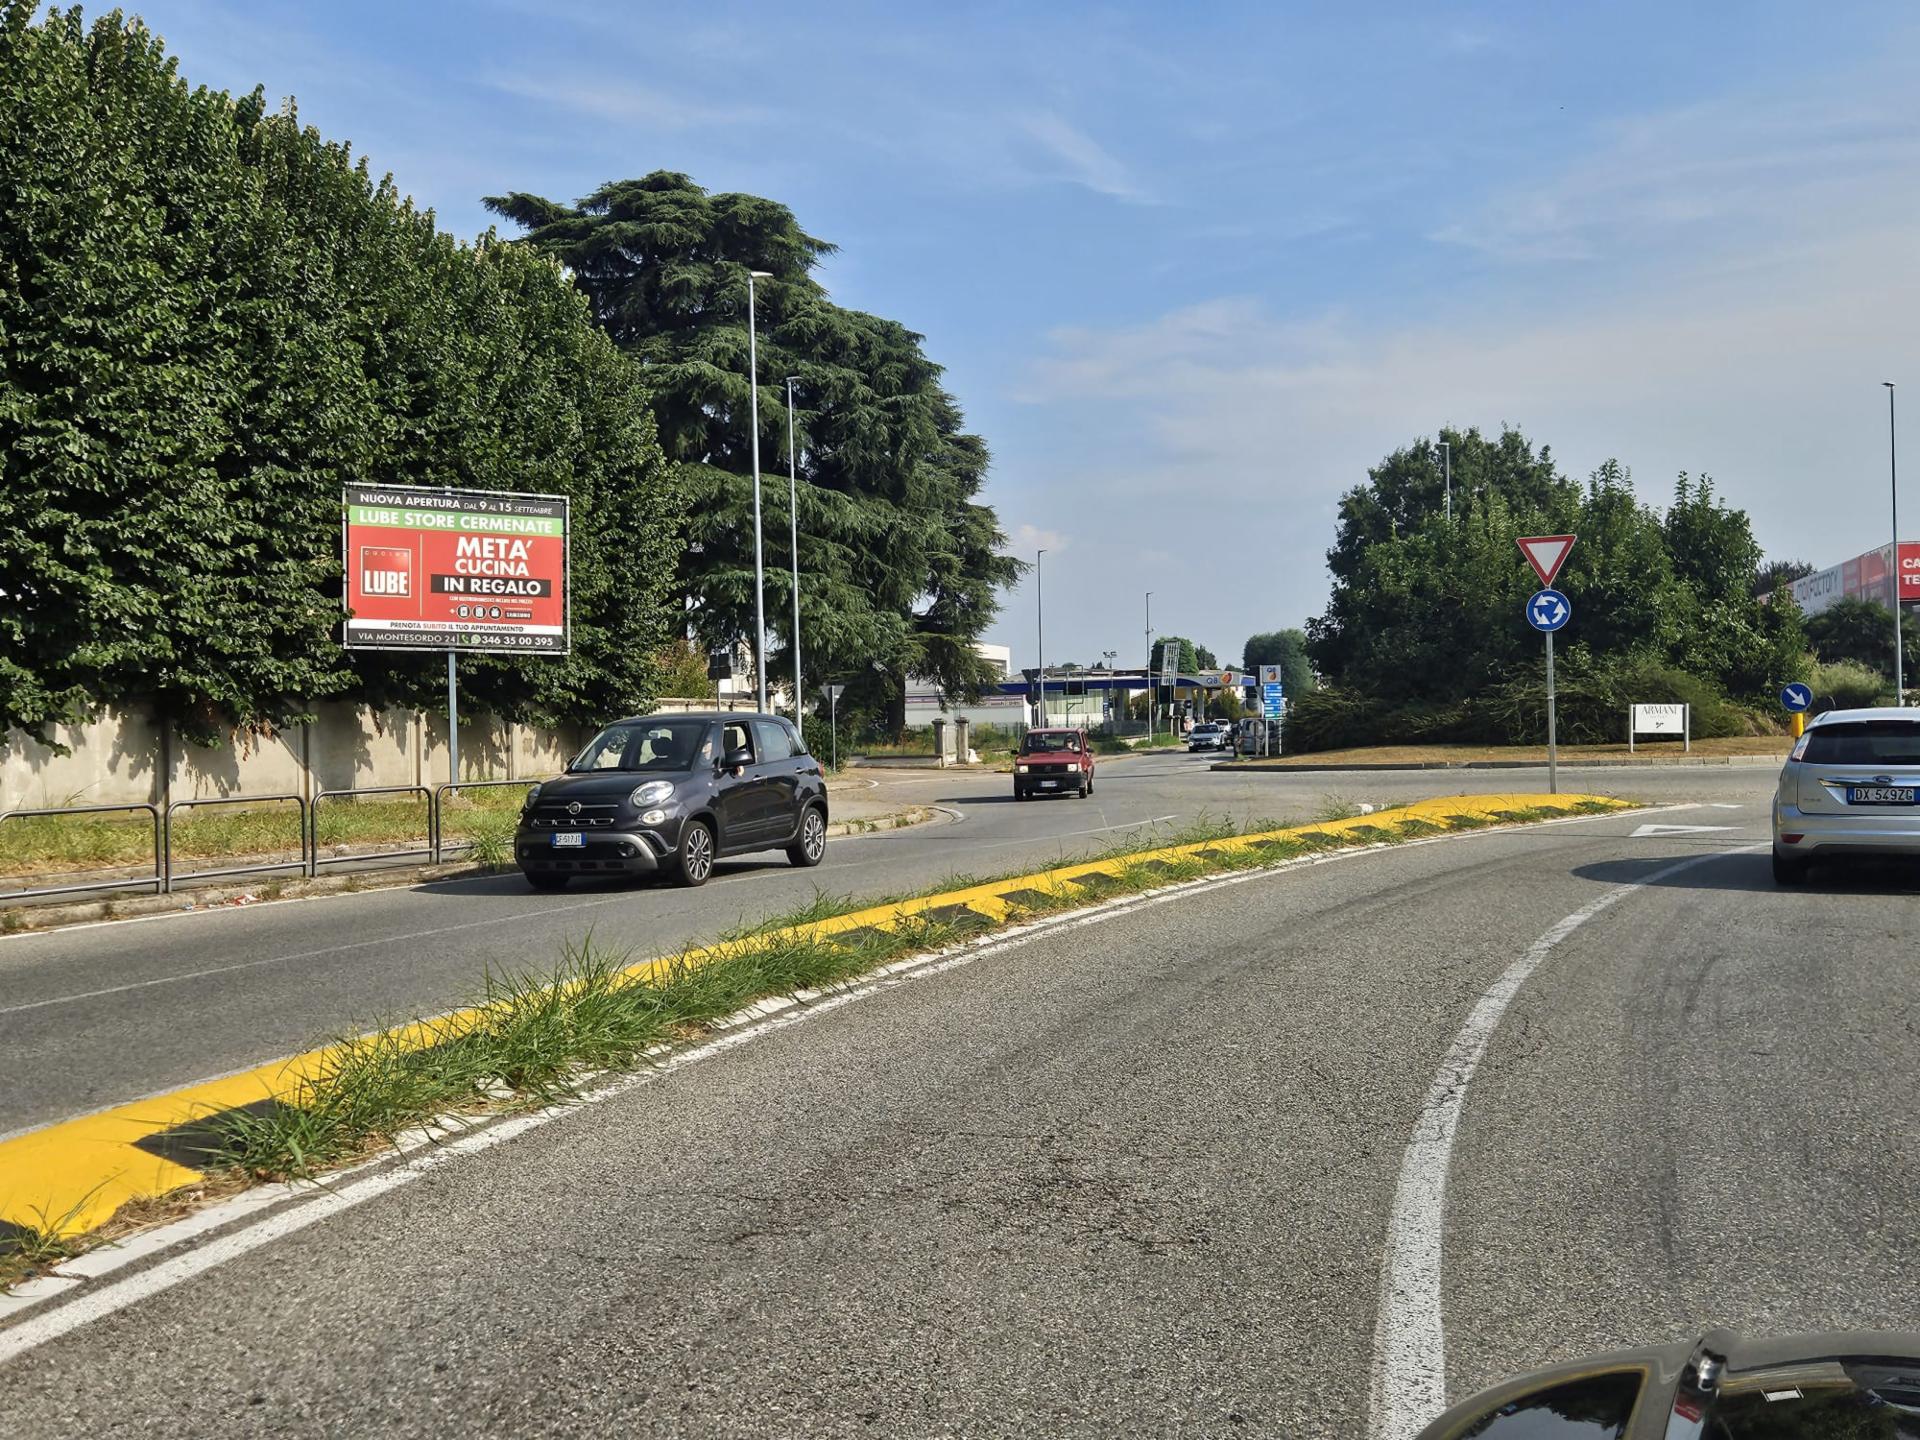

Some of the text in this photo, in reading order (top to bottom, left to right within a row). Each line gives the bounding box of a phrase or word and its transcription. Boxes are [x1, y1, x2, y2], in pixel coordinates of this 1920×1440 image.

[360, 493, 403, 505] NUOVA
[405, 496, 461, 509] APERTURA
[463, 502, 478, 510] DAL
[479, 501, 487, 510] 9
[499, 502, 512, 512] 15
[514, 505, 553, 515] SETTEMBRE
[360, 510, 553, 534] LUBE STORE CERMENATE
[455, 558, 530, 577] CUCINA
[364, 570, 408, 594] LUBE
[443, 576, 542, 595] IN REGALO
[390, 621, 421, 629] PRENOTA
[470, 624, 524, 632] APPUNTAMENTO
[358, 632, 553, 646] VIA MONTESORDO 24 346 35 00 395
[1642, 705, 1677, 715] ARMANI
[1855, 788, 1913, 801] DX 549ZG
